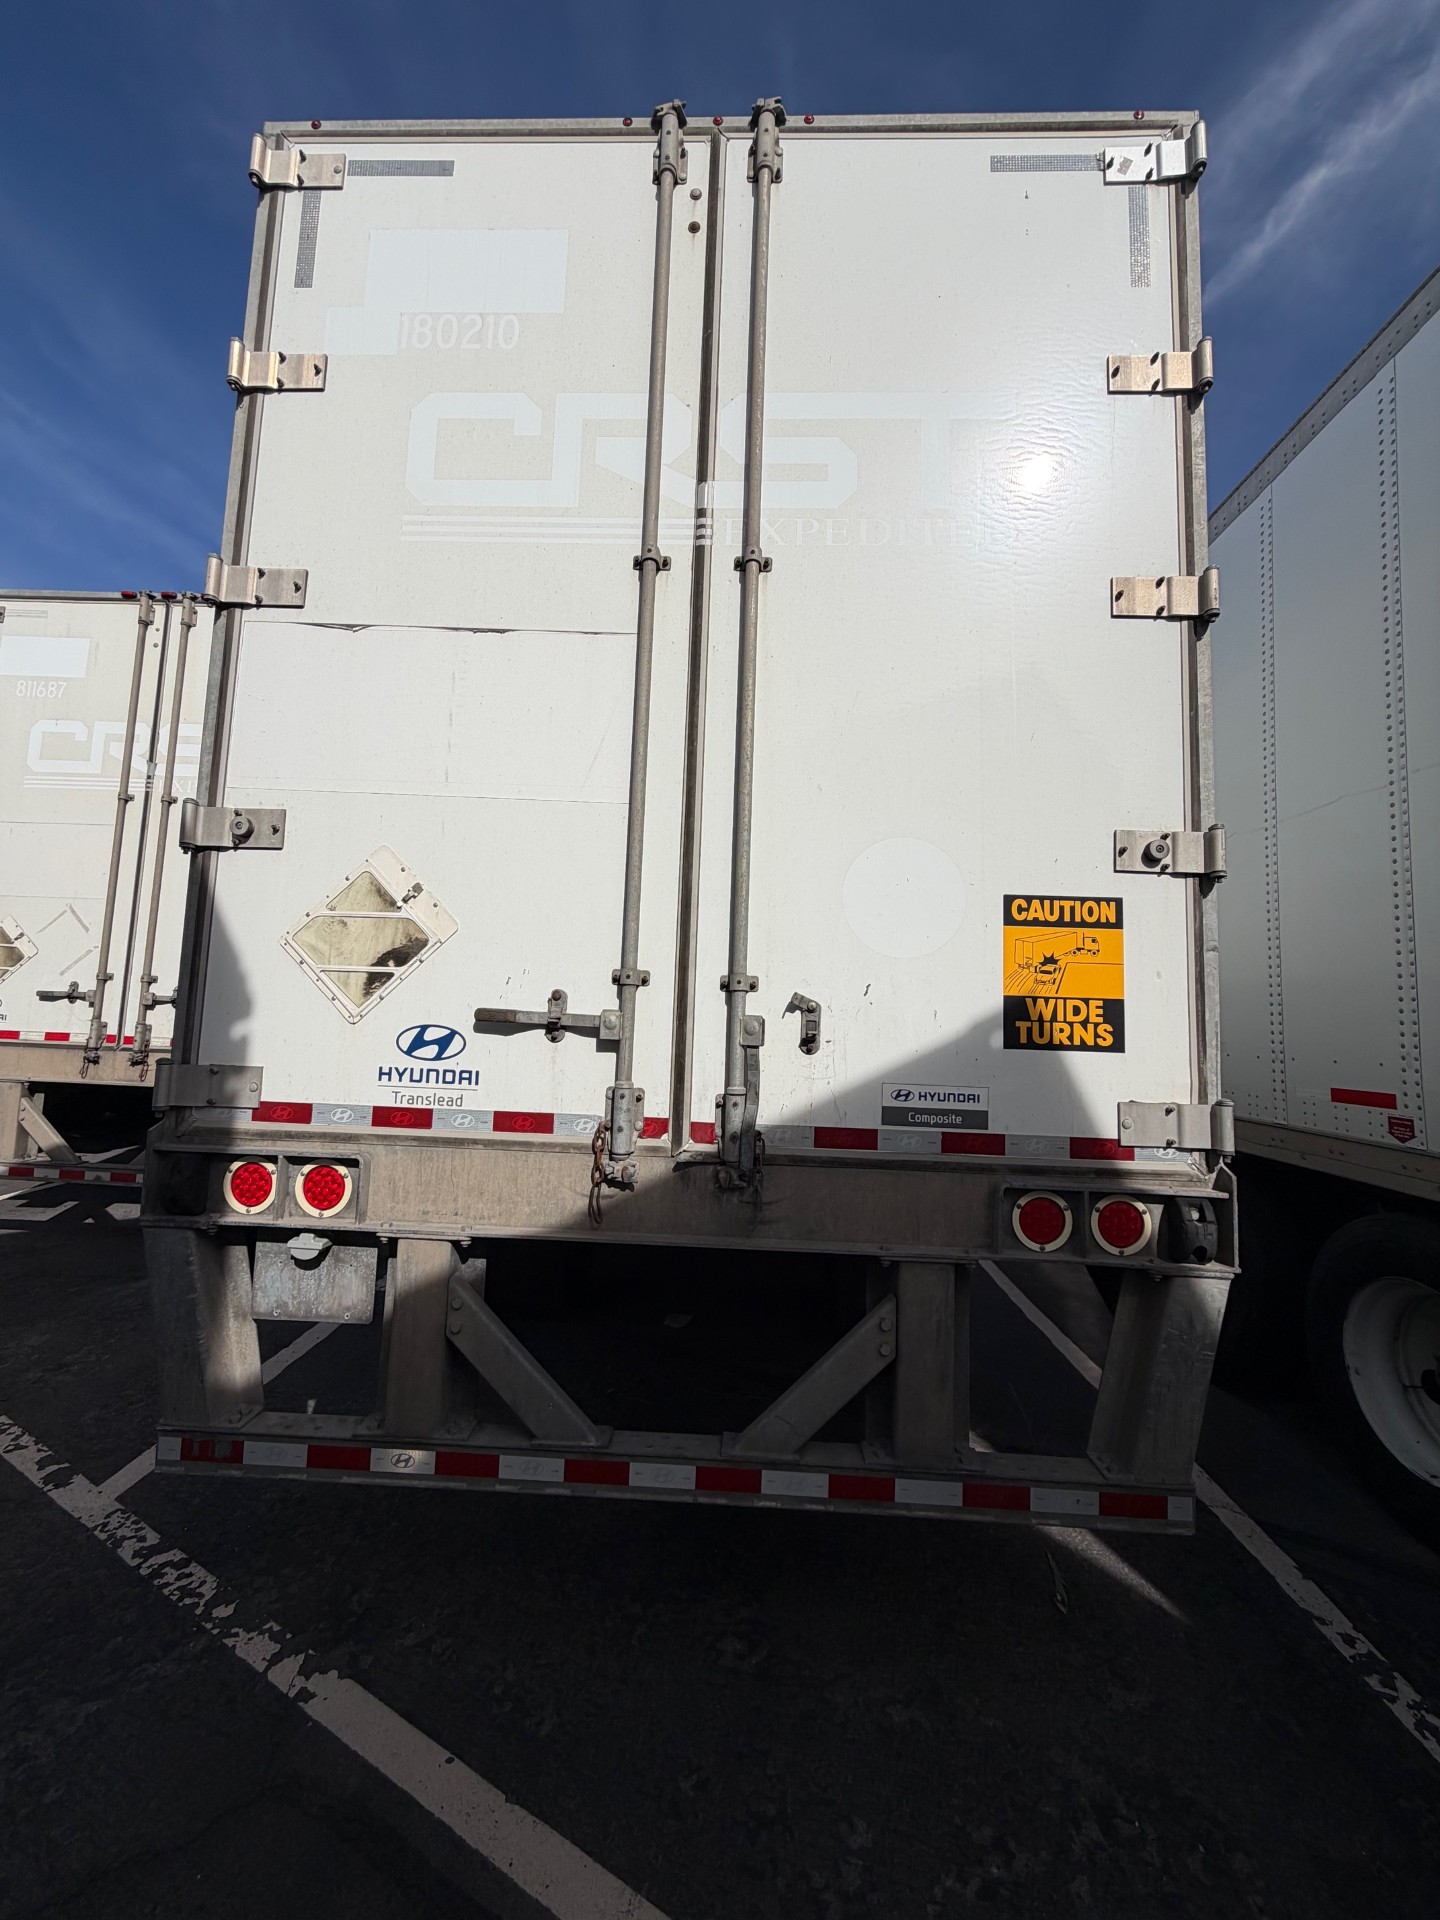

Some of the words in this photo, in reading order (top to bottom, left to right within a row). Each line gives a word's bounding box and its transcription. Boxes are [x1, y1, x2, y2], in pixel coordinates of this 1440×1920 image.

[16, 680, 68, 699] 811687
[1011, 898, 1117, 924] CAUTION
[1025, 997, 1104, 1023] WIDE
[1015, 1020, 1114, 1047] TURNS
[377, 1066, 480, 1087] HYUNDAI
[391, 1090, 464, 1107] Translead
[918, 1091, 981, 1104] HYUNDAI
[908, 1111, 963, 1125] Composite
